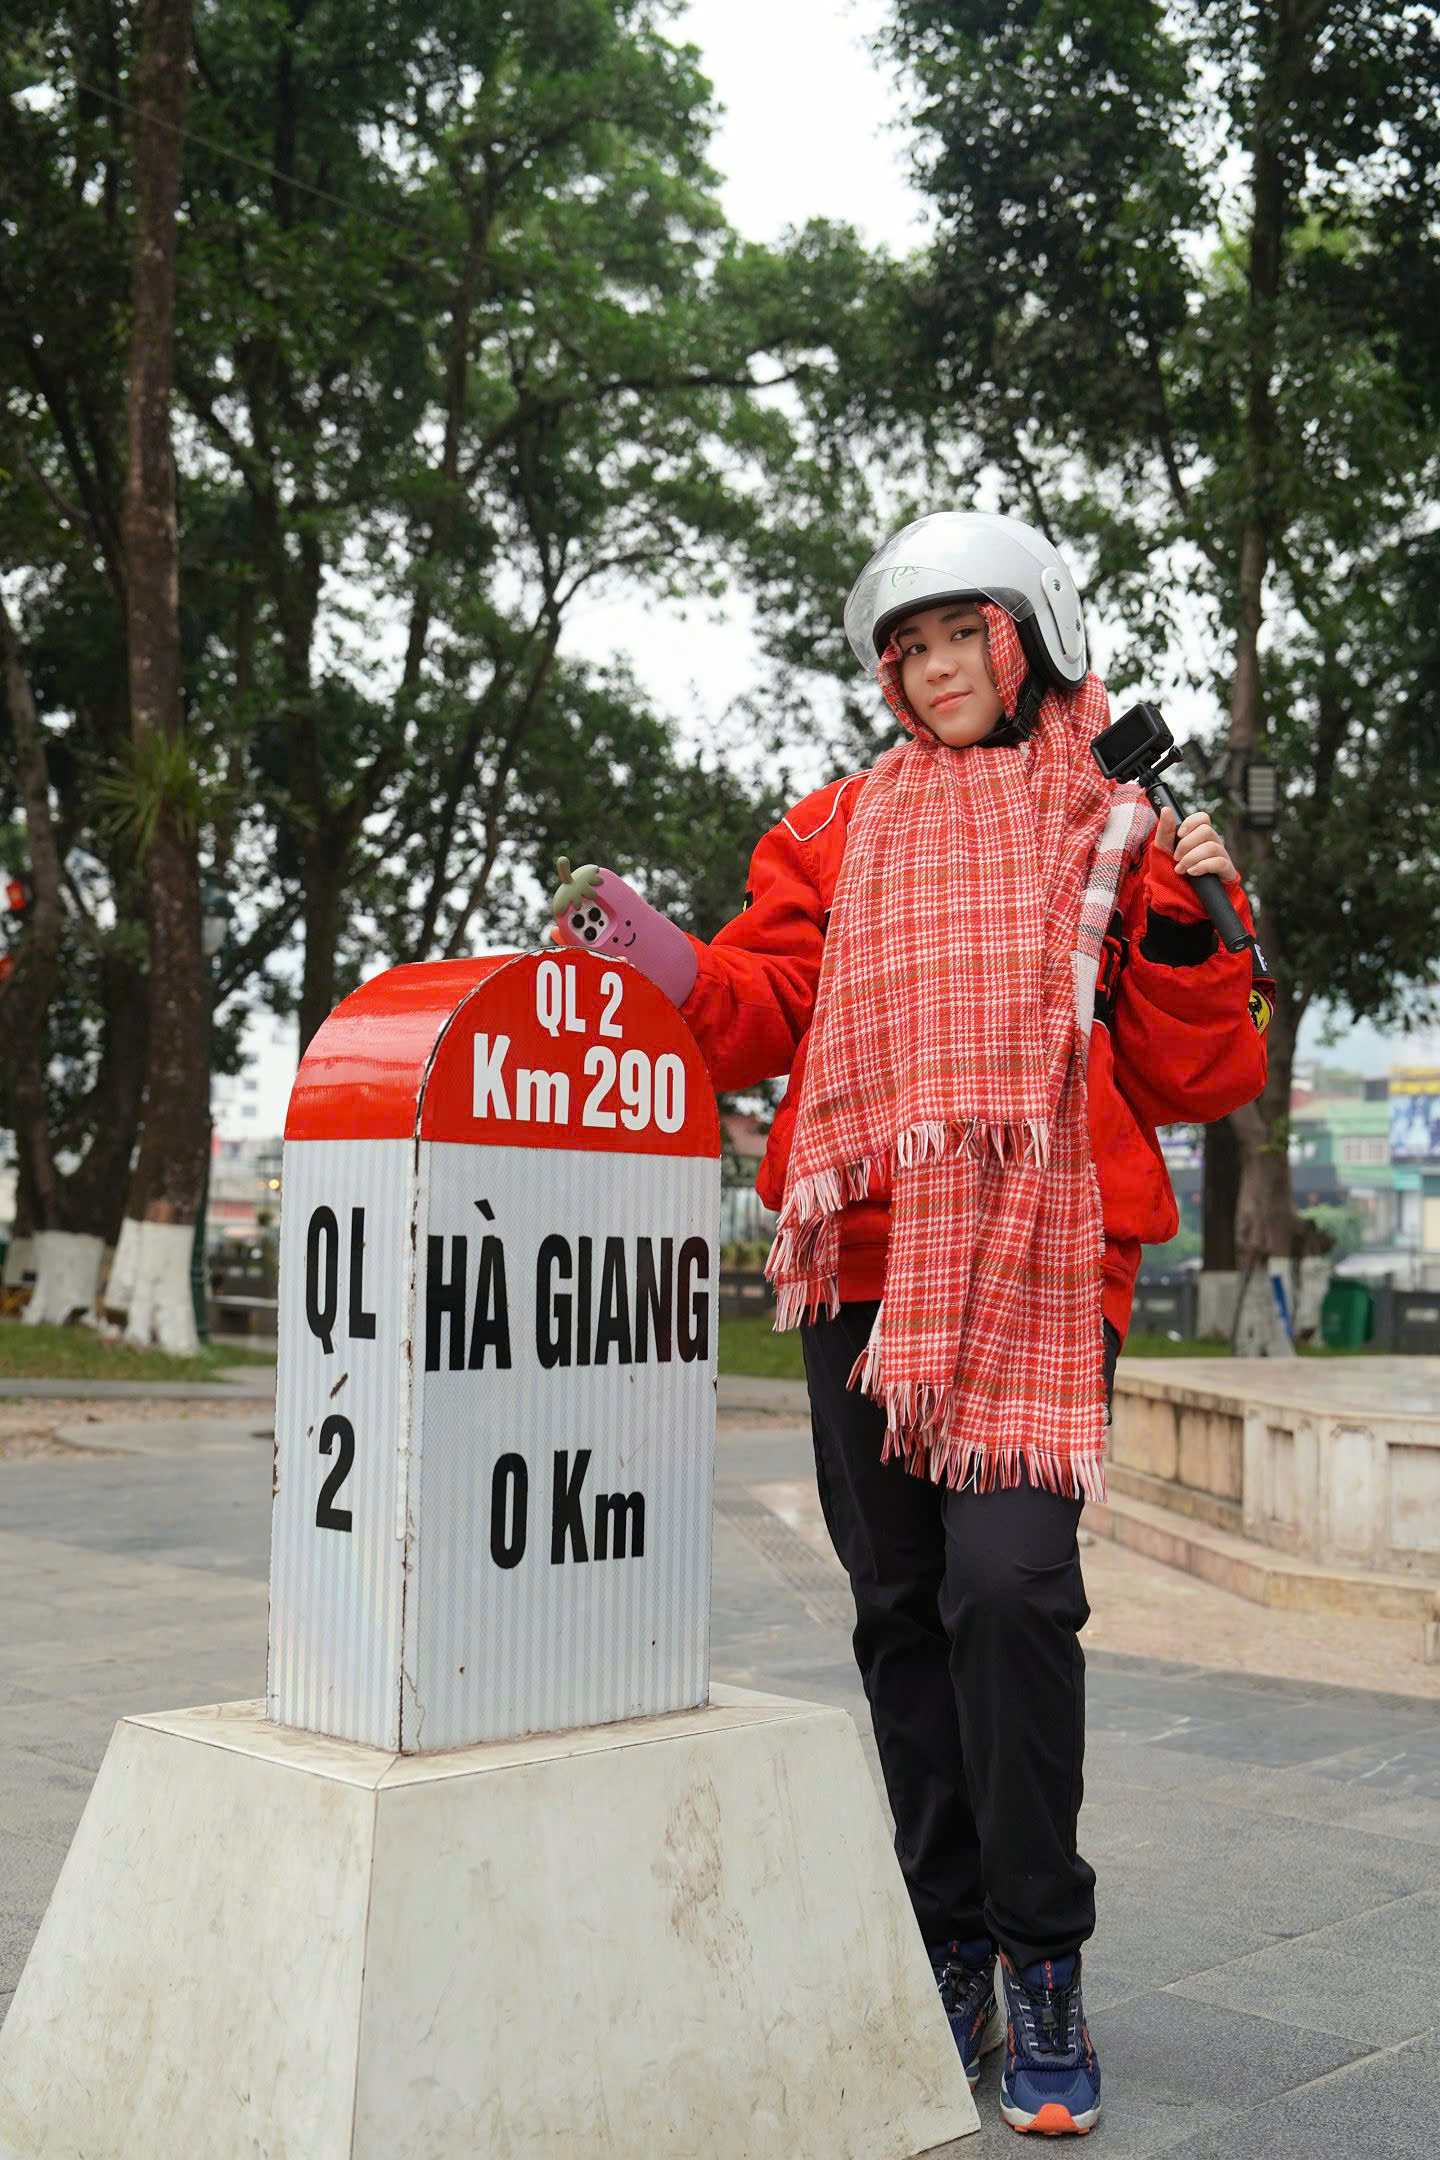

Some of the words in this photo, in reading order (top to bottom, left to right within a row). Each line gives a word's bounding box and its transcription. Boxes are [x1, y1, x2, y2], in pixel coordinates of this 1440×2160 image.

[536, 960, 586, 1037] QL
[599, 971, 624, 1039] 2
[472, 1032, 570, 1125] Km
[582, 1045, 686, 1134] 290
[305, 1205, 376, 1355] QL
[424, 1199, 512, 1372] HÀ
[535, 1233, 709, 1370] GIANG
[315, 1414, 355, 1533] 2
[490, 1452, 529, 1570] 0
[550, 1449, 646, 1565] Km
